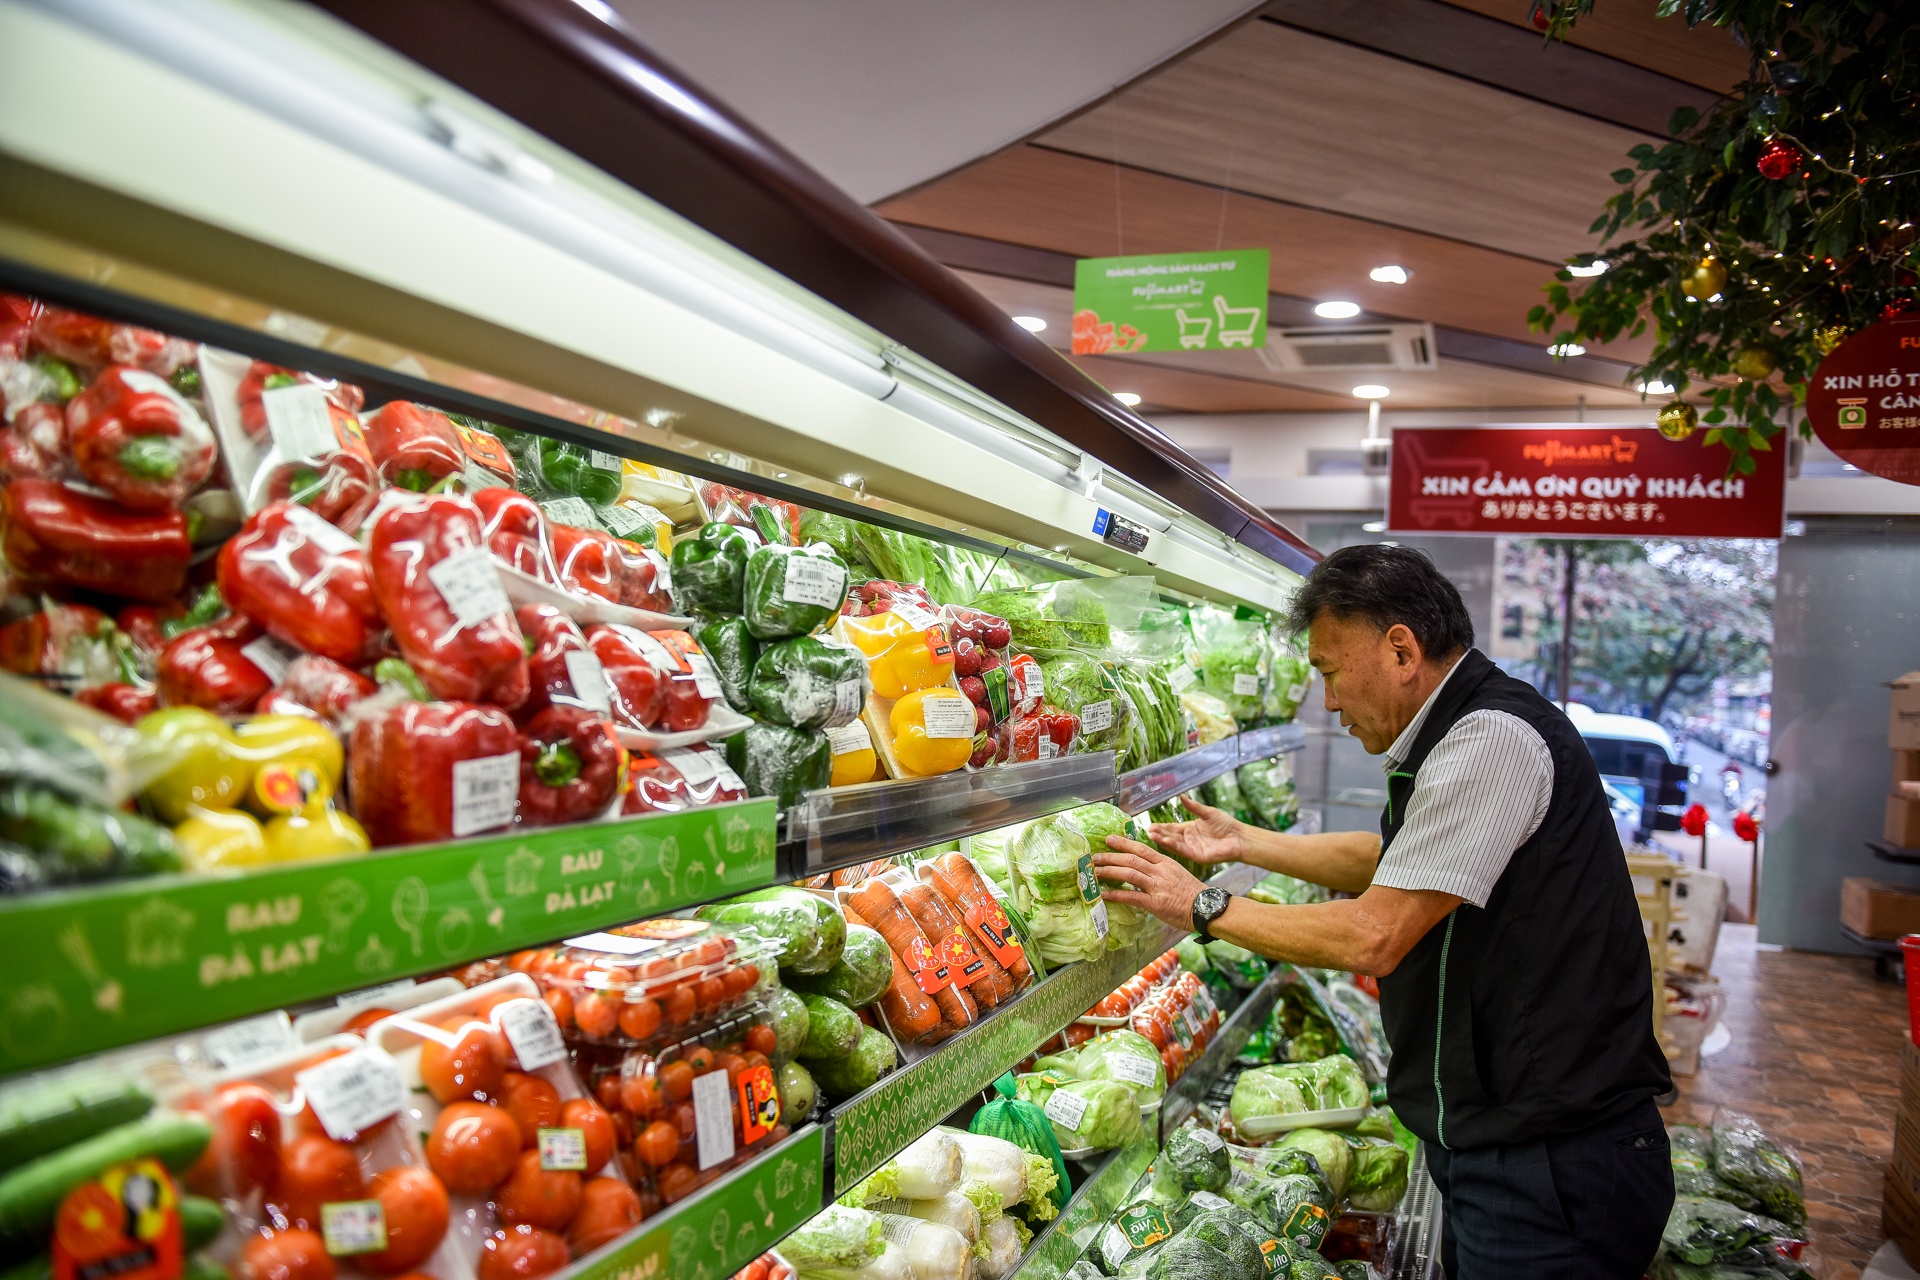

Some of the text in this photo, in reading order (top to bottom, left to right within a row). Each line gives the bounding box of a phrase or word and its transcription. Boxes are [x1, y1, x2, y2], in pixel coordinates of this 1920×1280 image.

[1824, 376, 1863, 390] XIN
[1879, 417, 1920, 429] お客様
[1421, 471, 1744, 499] XIN CẢM ƠN QUÝ KHÁCH
[1481, 500, 1665, 522] ありがとうございます。
[561, 848, 604, 876] RAU
[226, 894, 303, 936] RAU
